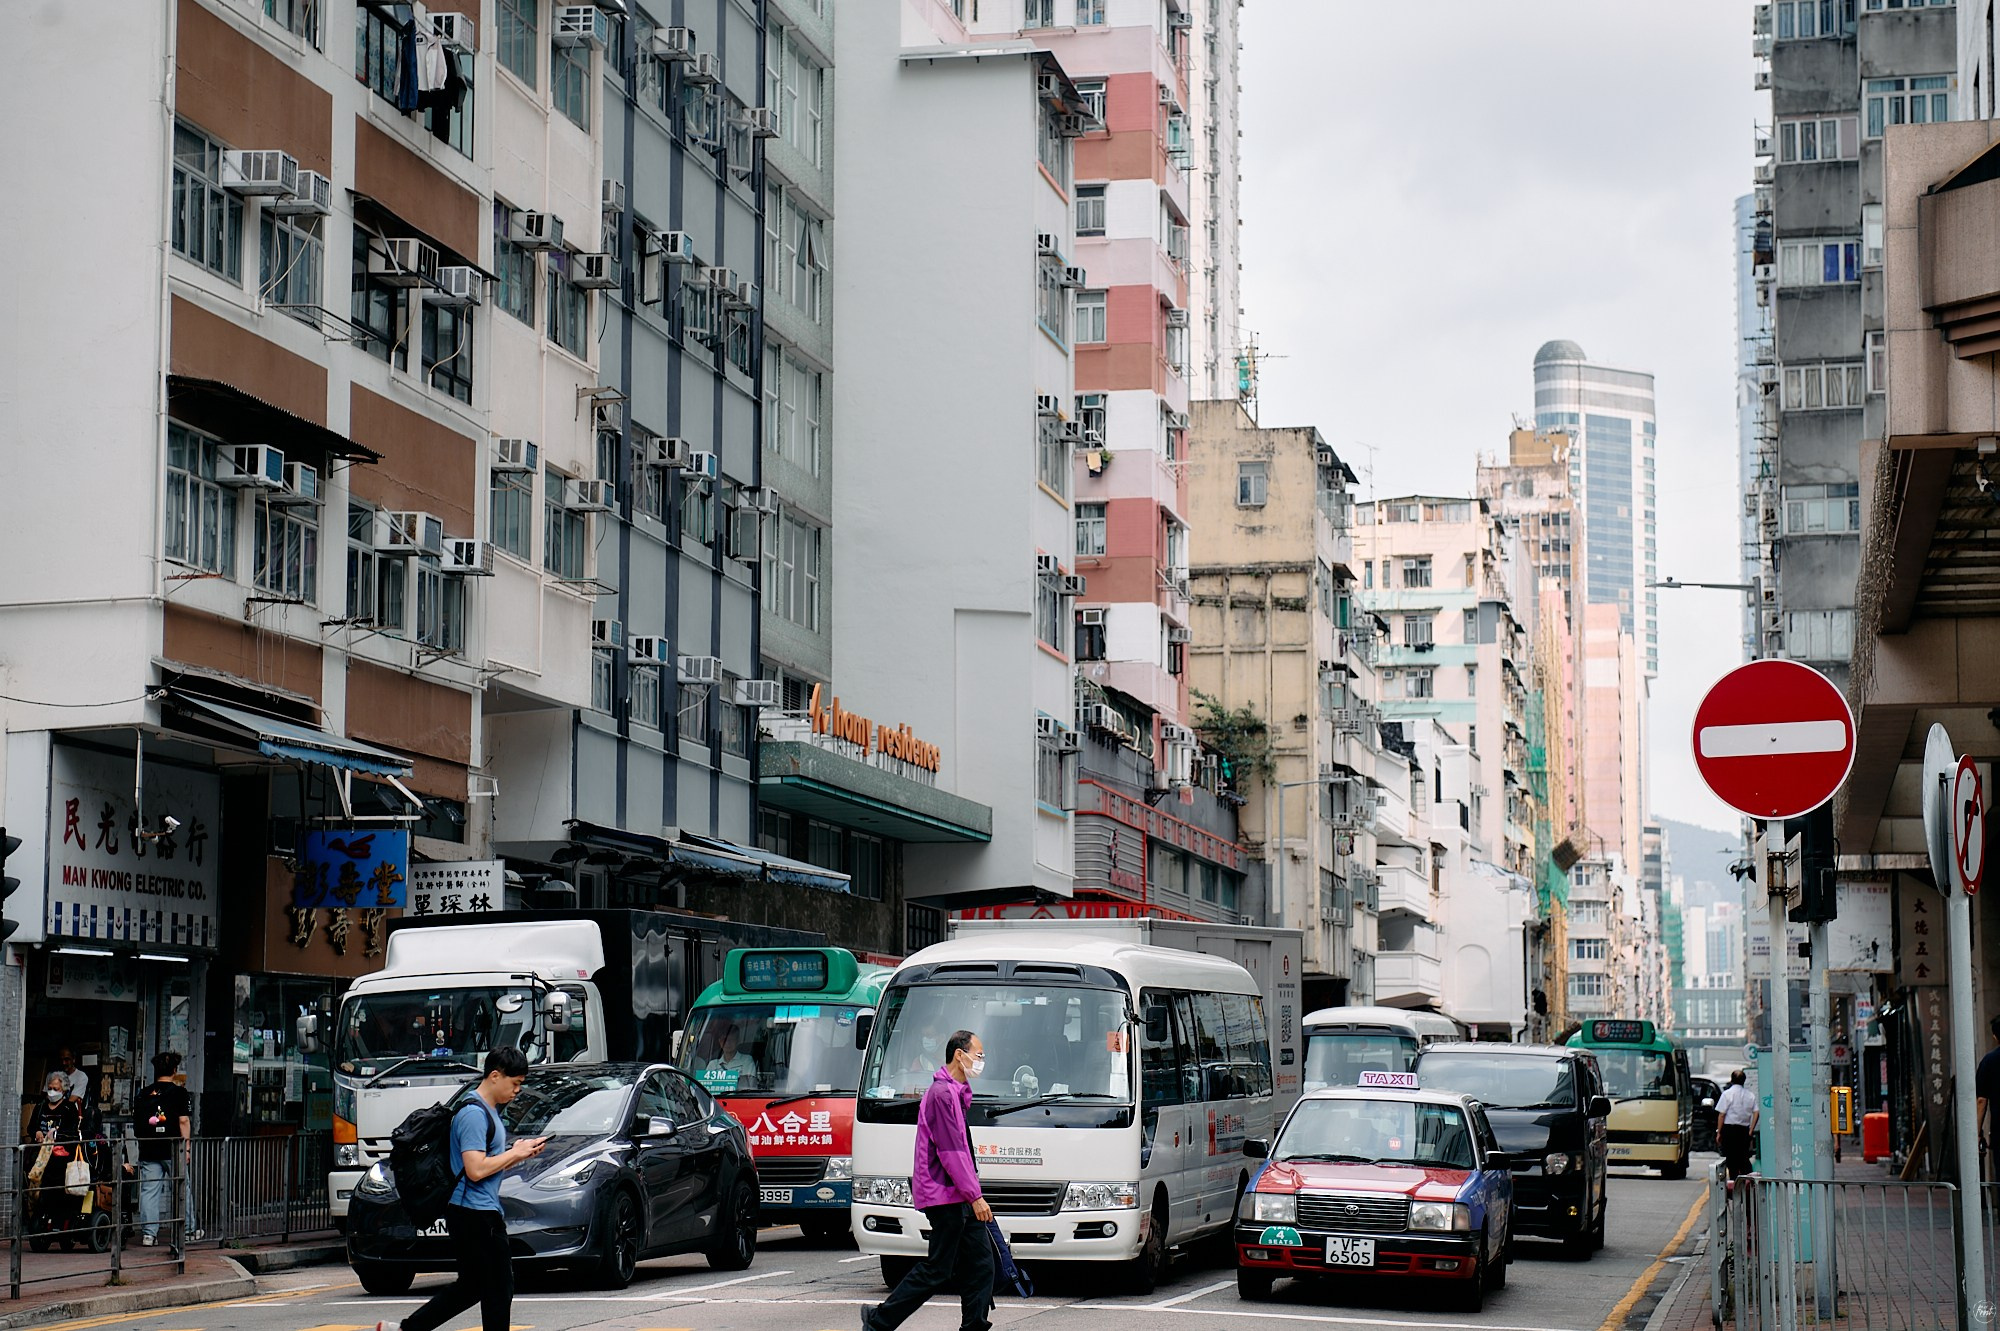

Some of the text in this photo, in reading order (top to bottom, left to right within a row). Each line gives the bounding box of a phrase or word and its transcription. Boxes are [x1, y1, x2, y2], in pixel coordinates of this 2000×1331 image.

[878, 723, 941, 773] residence
[63, 865, 206, 900] MAN KWONG ELECTRIC CO.
[704, 1071, 726, 1080] 43M
[1364, 1073, 1413, 1085] TAXI
[749, 1110, 833, 1134] 八合里
[749, 1134, 833, 1146] 潮汕鮮牛肉火鍋
[1276, 1230, 1285, 1239] 4
[1341, 1239, 1361, 1251] VF
[1330, 1250, 1371, 1265] 6505
